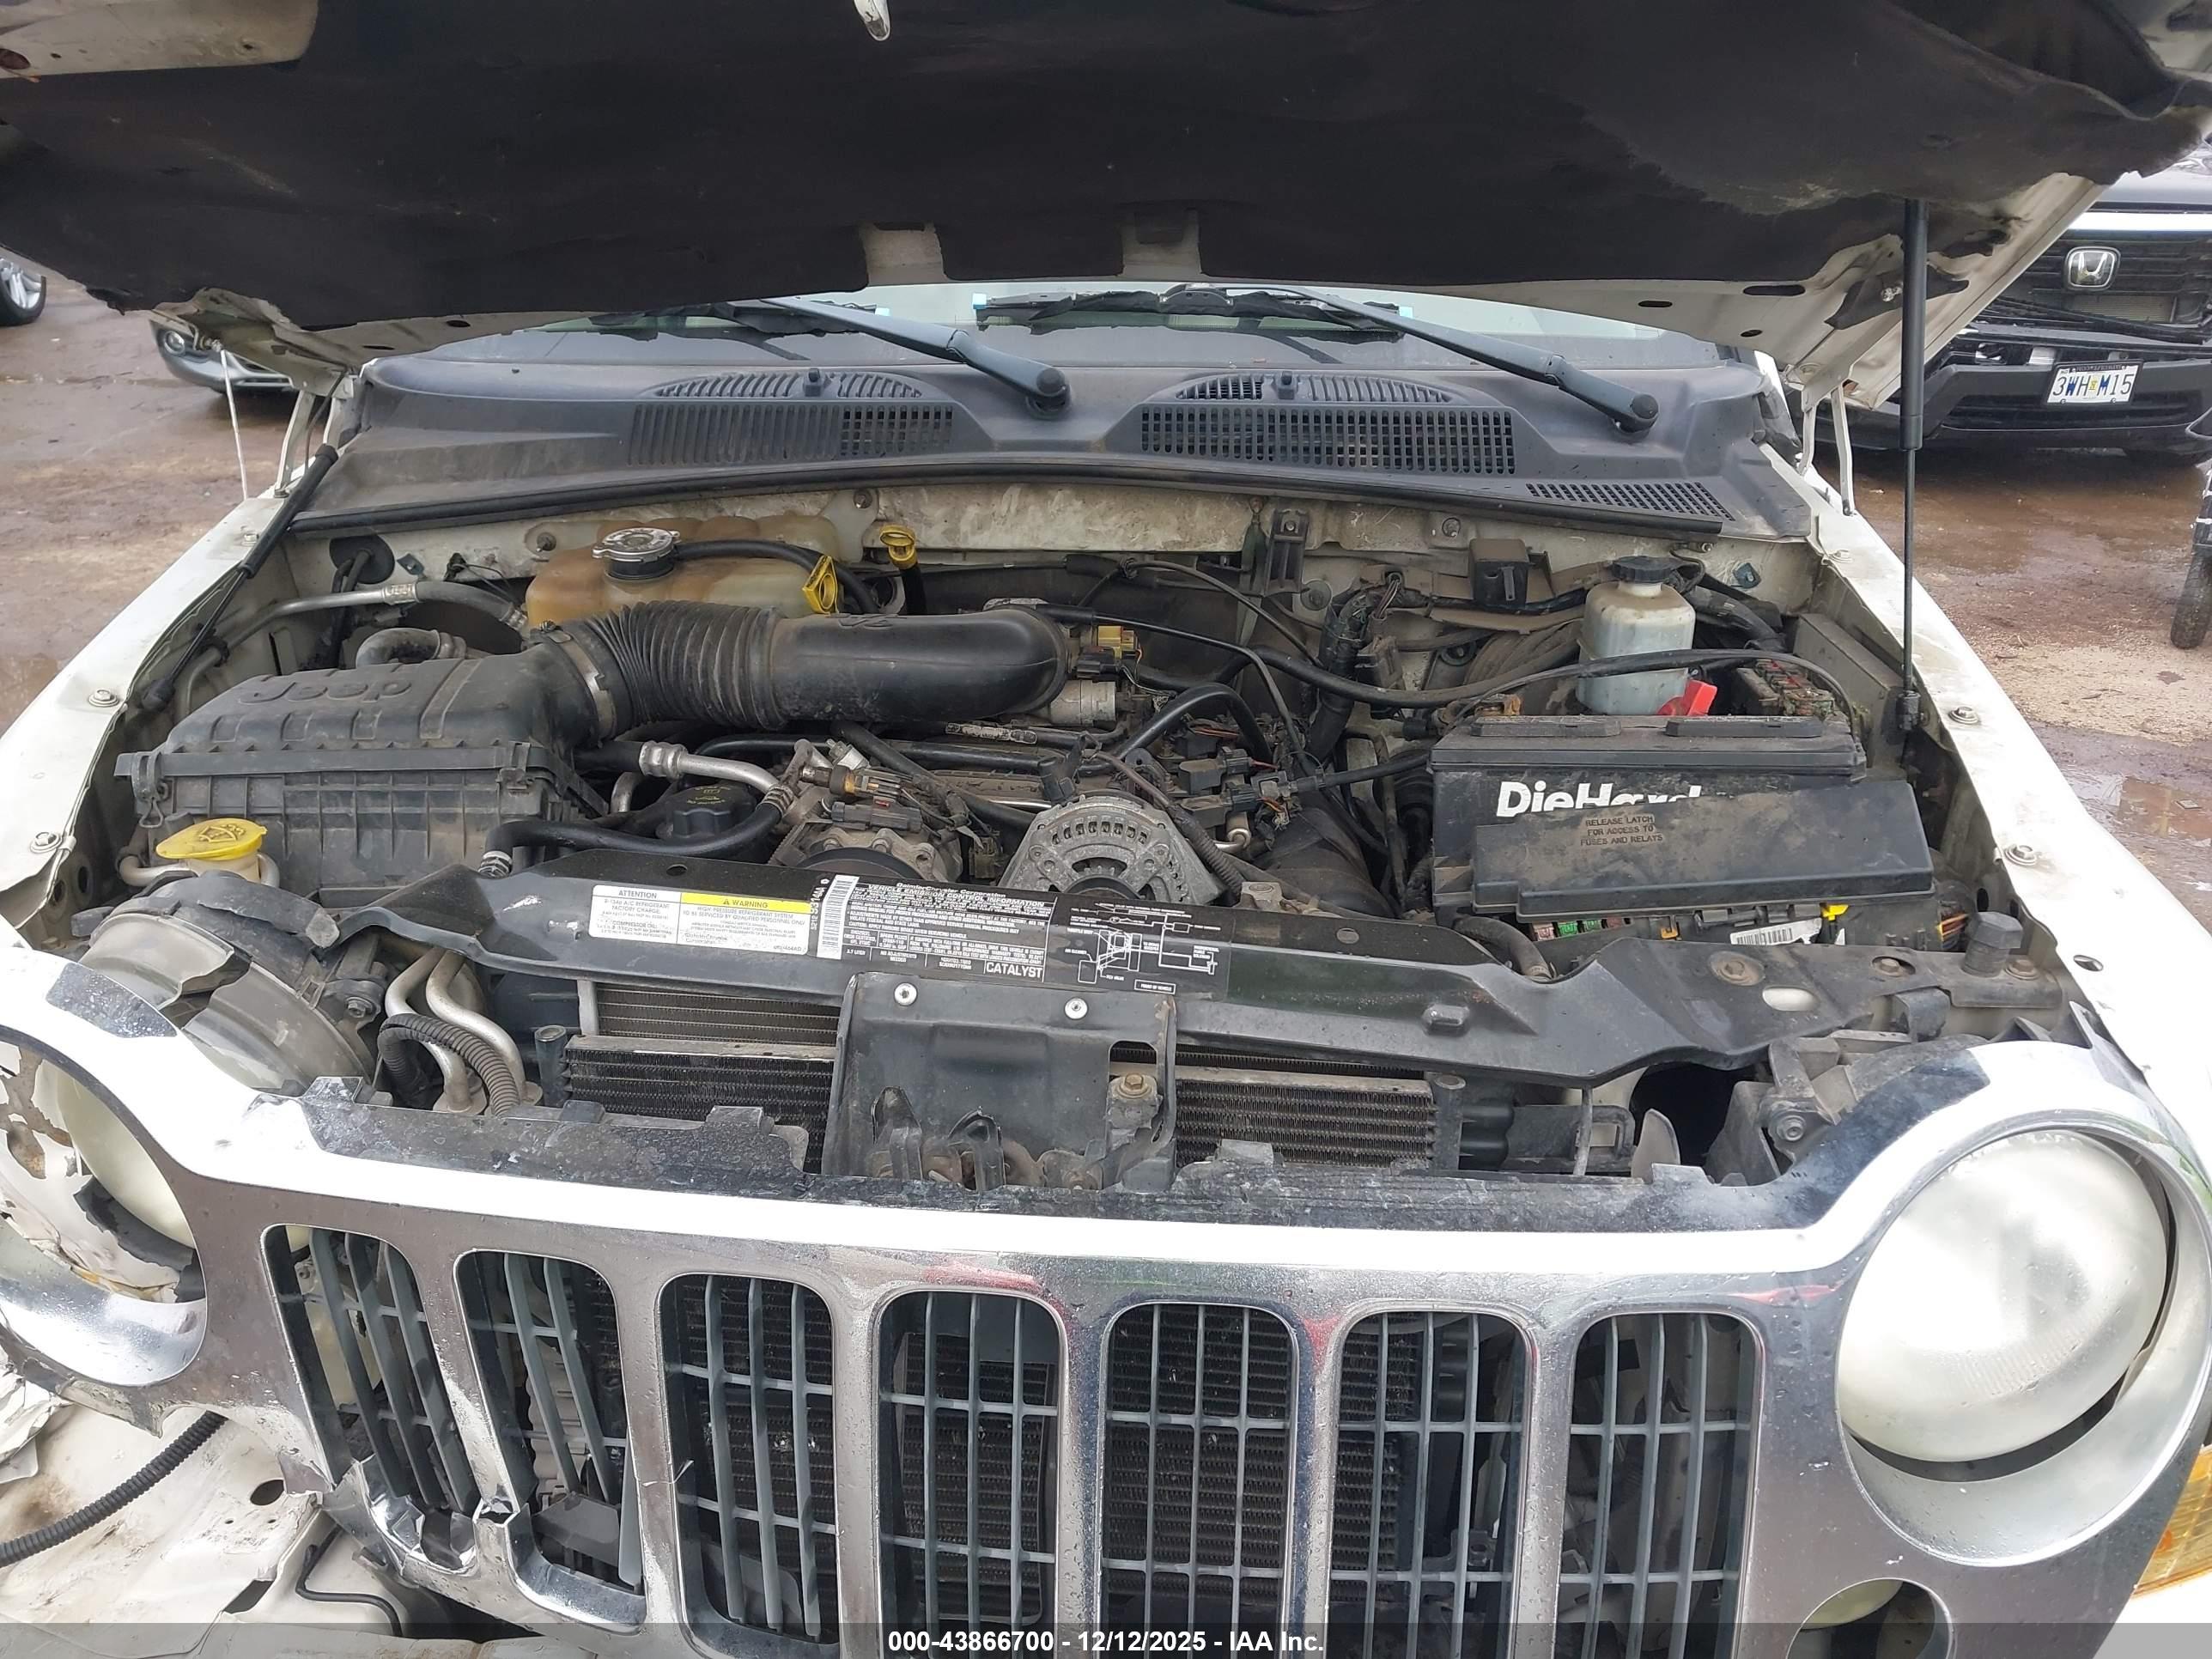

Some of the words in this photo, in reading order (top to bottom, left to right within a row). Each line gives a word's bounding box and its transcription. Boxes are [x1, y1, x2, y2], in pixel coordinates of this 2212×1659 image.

[2052, 375, 2092, 397] 3WH
[2097, 374, 2135, 397] M15
[239, 681, 412, 704] Jeep
[1585, 817, 1623, 827] RELEASE
[1626, 815, 1654, 824] LATCH
[1607, 825, 1640, 835] ACCESS
[1580, 838, 1607, 847] FUSES
[1610, 836, 1628, 845] AND
[1630, 834, 1663, 844] RELAYS
[618, 890, 657, 899] ATTENTION
[960, 888, 1006, 898] Corporation
[732, 899, 768, 908] WARNING
[987, 896, 1045, 907] INFORMATION
[986, 962, 1043, 978] CATALYST
